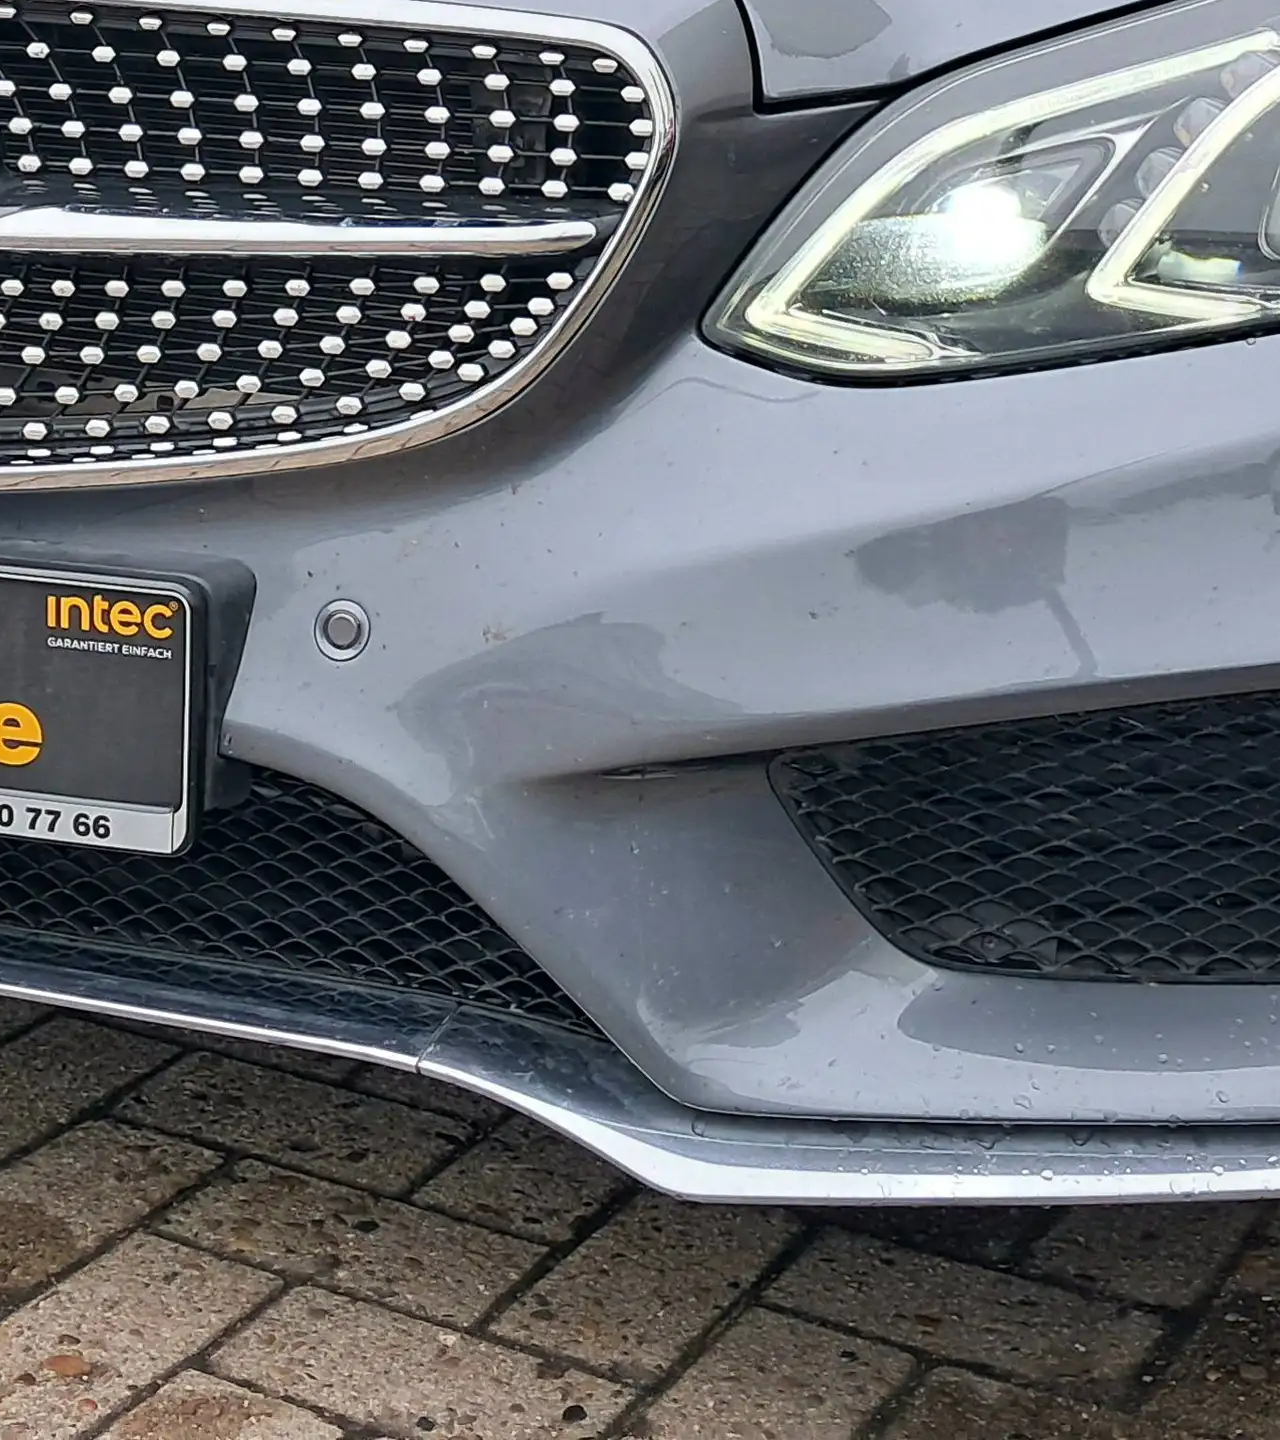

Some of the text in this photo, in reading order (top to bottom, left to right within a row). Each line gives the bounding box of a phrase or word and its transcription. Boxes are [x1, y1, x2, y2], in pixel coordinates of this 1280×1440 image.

[47, 637, 173, 660] GARANTIERT EINFACH
[25, 807, 62, 833] 77
[72, 813, 112, 839] 66
